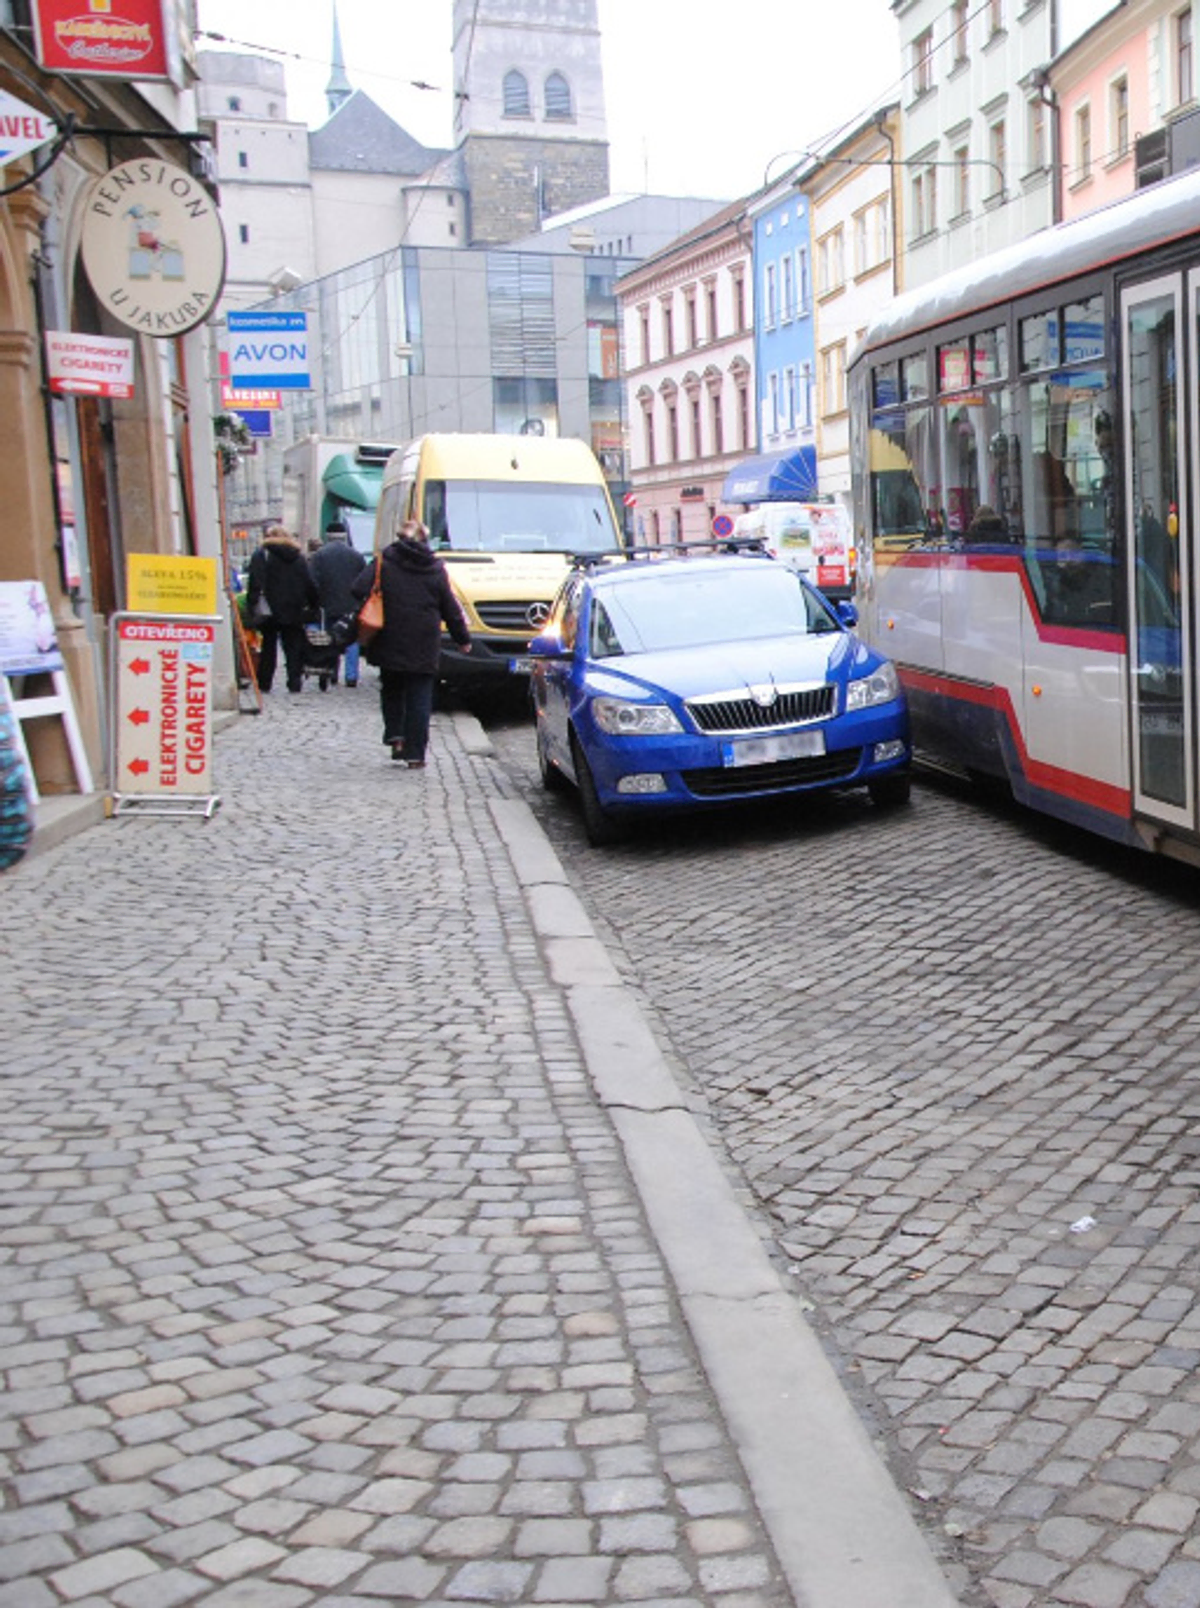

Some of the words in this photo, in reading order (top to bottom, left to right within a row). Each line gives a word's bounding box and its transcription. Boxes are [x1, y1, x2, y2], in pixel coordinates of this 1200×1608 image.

[92, 163, 208, 218] PENSION
[110, 288, 129, 306] U
[128, 292, 209, 330] JAKUBA
[60, 357, 123, 374] CIGARETY
[234, 344, 306, 361] AVON
[125, 624, 208, 639] OTEVŘENO
[159, 648, 179, 786] ELEKTRONICKÉ
[185, 662, 206, 775] CIGARETY
